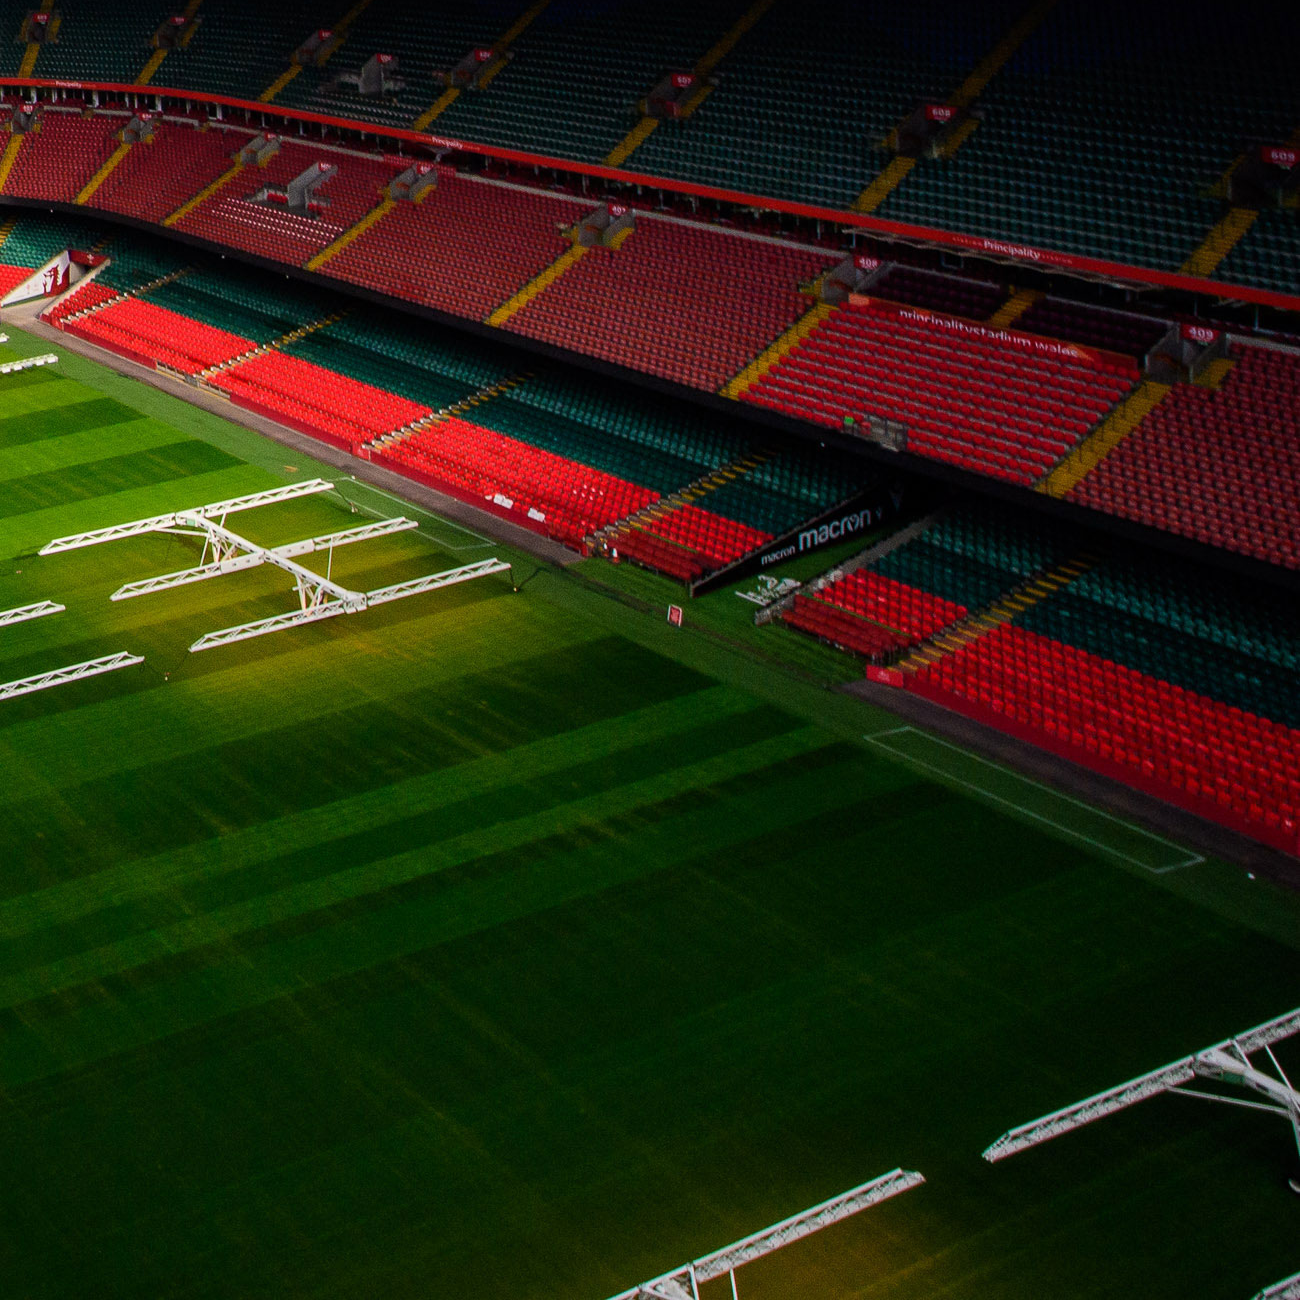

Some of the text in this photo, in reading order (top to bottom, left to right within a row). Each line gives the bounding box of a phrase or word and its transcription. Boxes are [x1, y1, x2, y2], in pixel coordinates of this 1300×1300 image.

[1270, 149, 1296, 163] 609
[983, 240, 1041, 261] Principality
[1189, 326, 1214, 340] 409
[760, 508, 872, 566] macron macron
